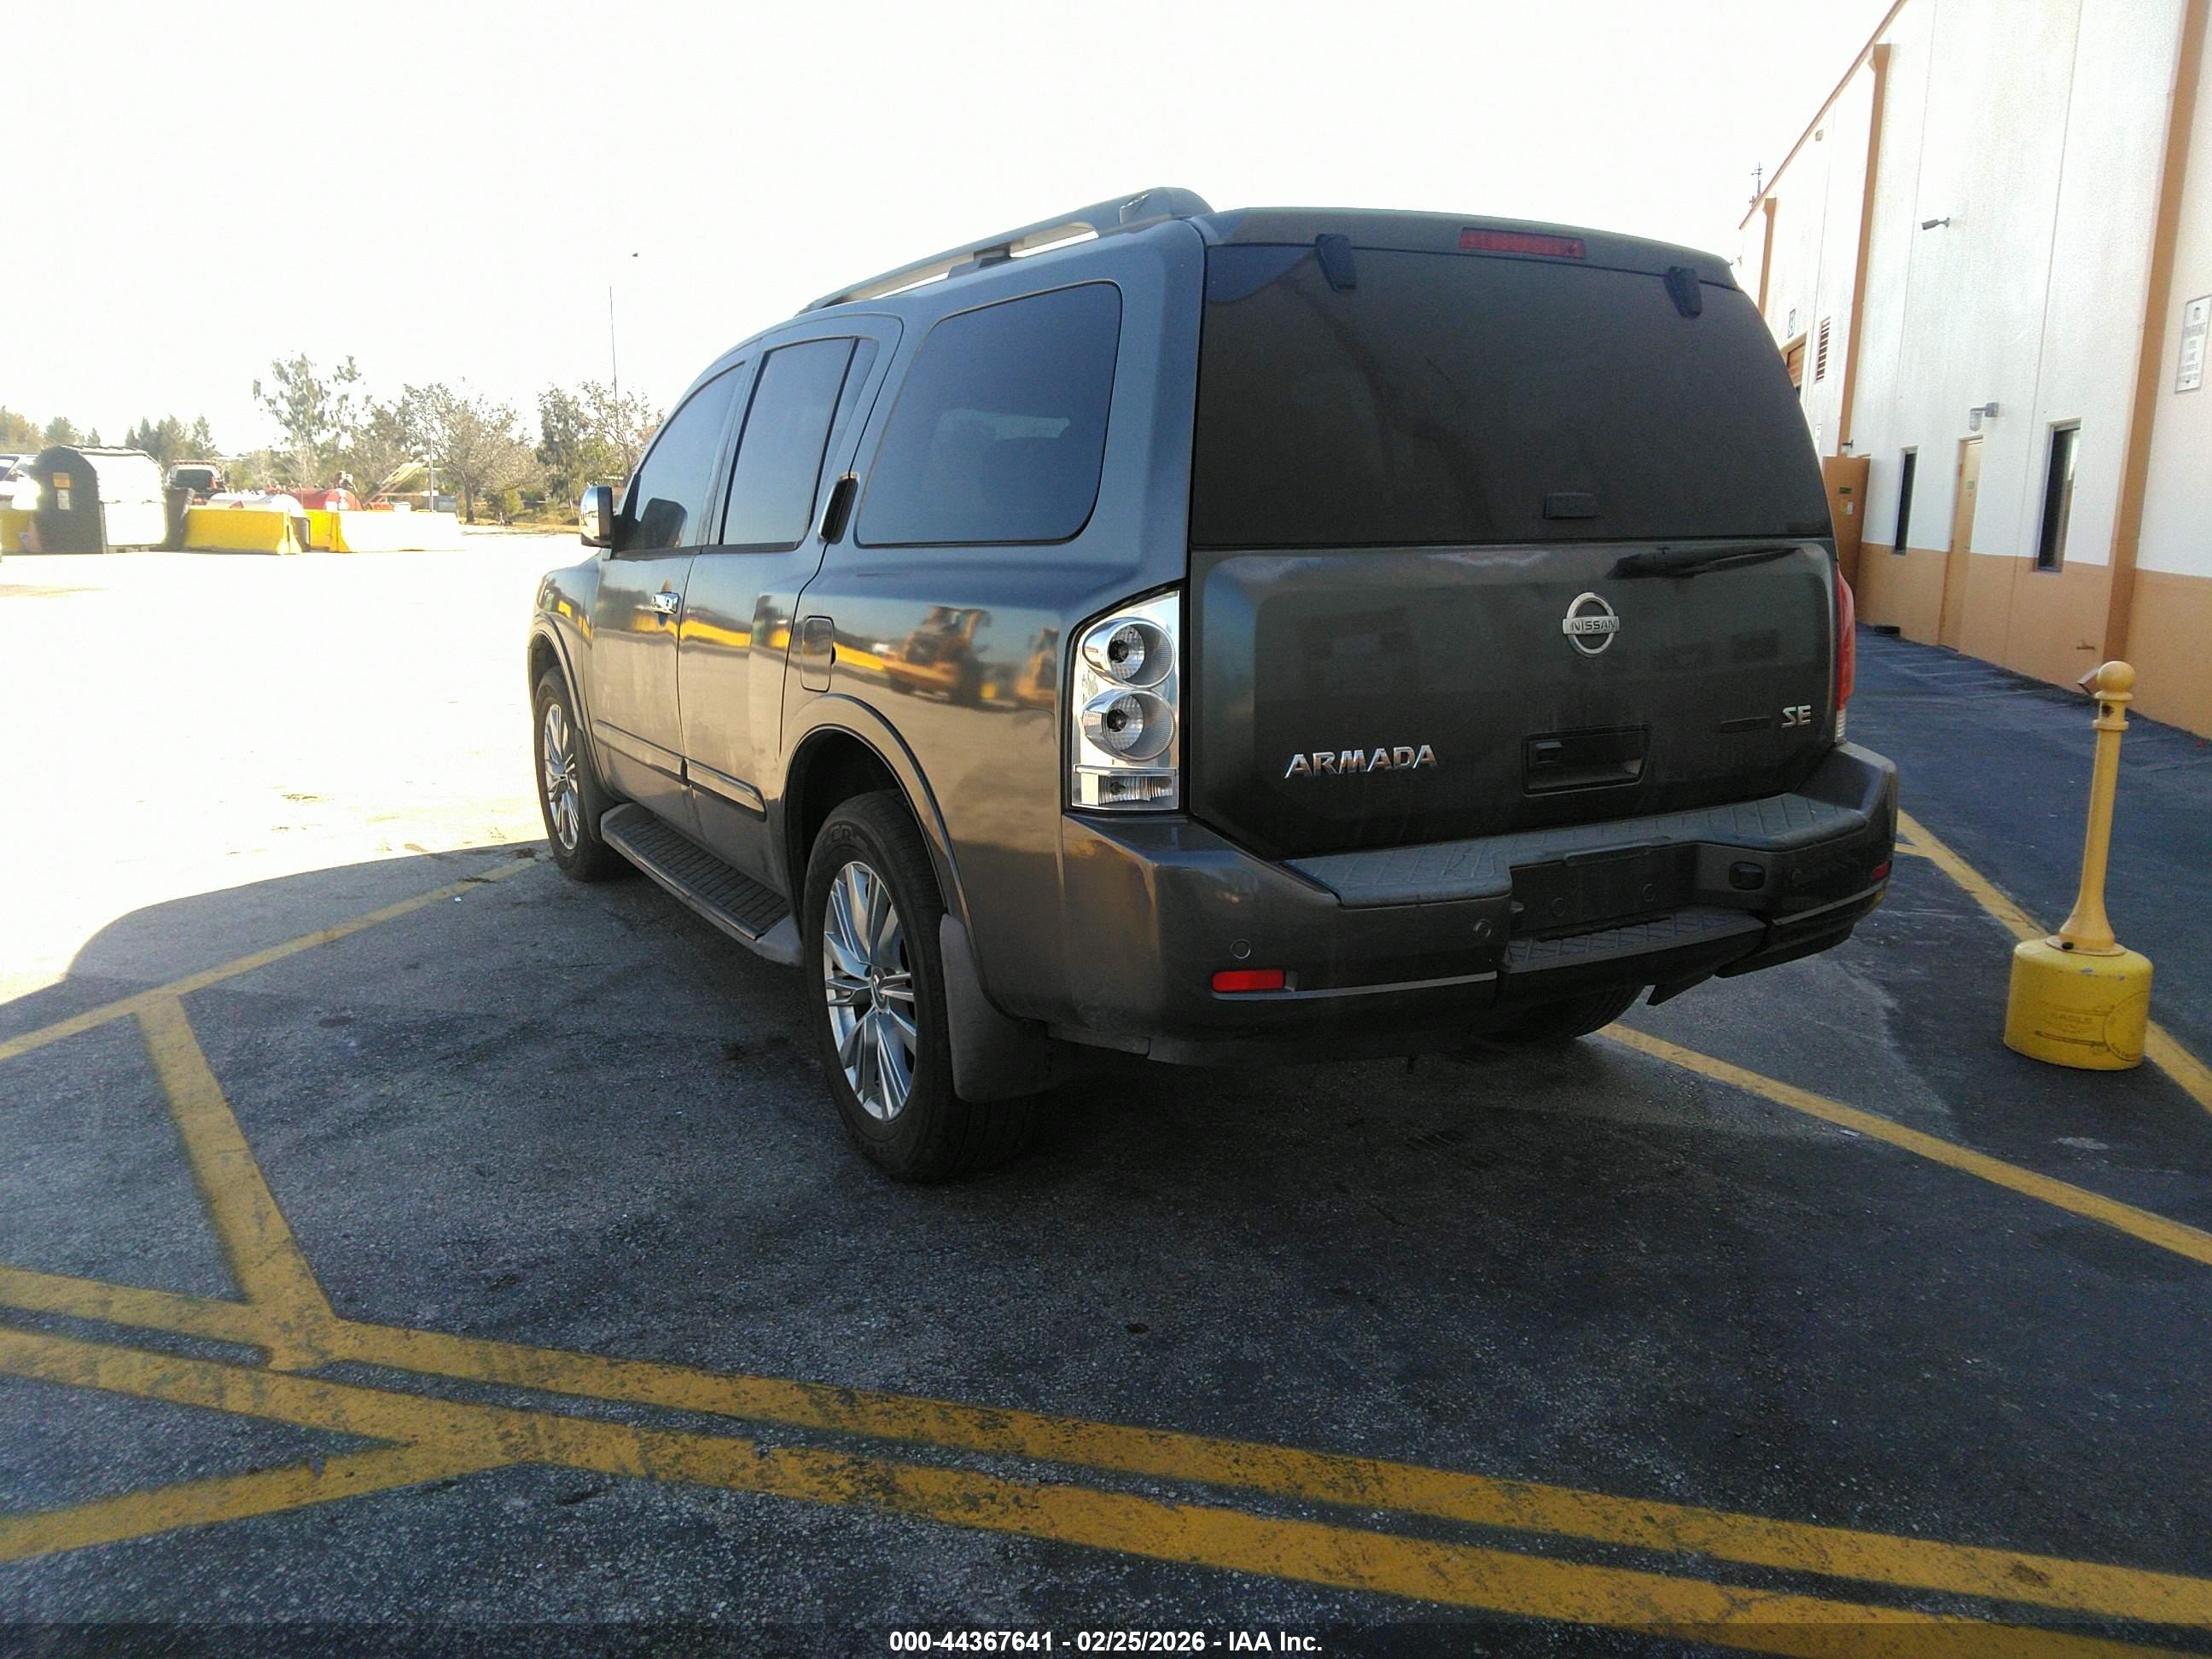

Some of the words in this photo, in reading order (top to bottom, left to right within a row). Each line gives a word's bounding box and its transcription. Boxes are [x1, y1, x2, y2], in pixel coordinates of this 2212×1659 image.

[1571, 620, 1615, 632] NISSAN
[1781, 705, 1812, 728] SE
[1284, 744, 1439, 779] ARMADA
